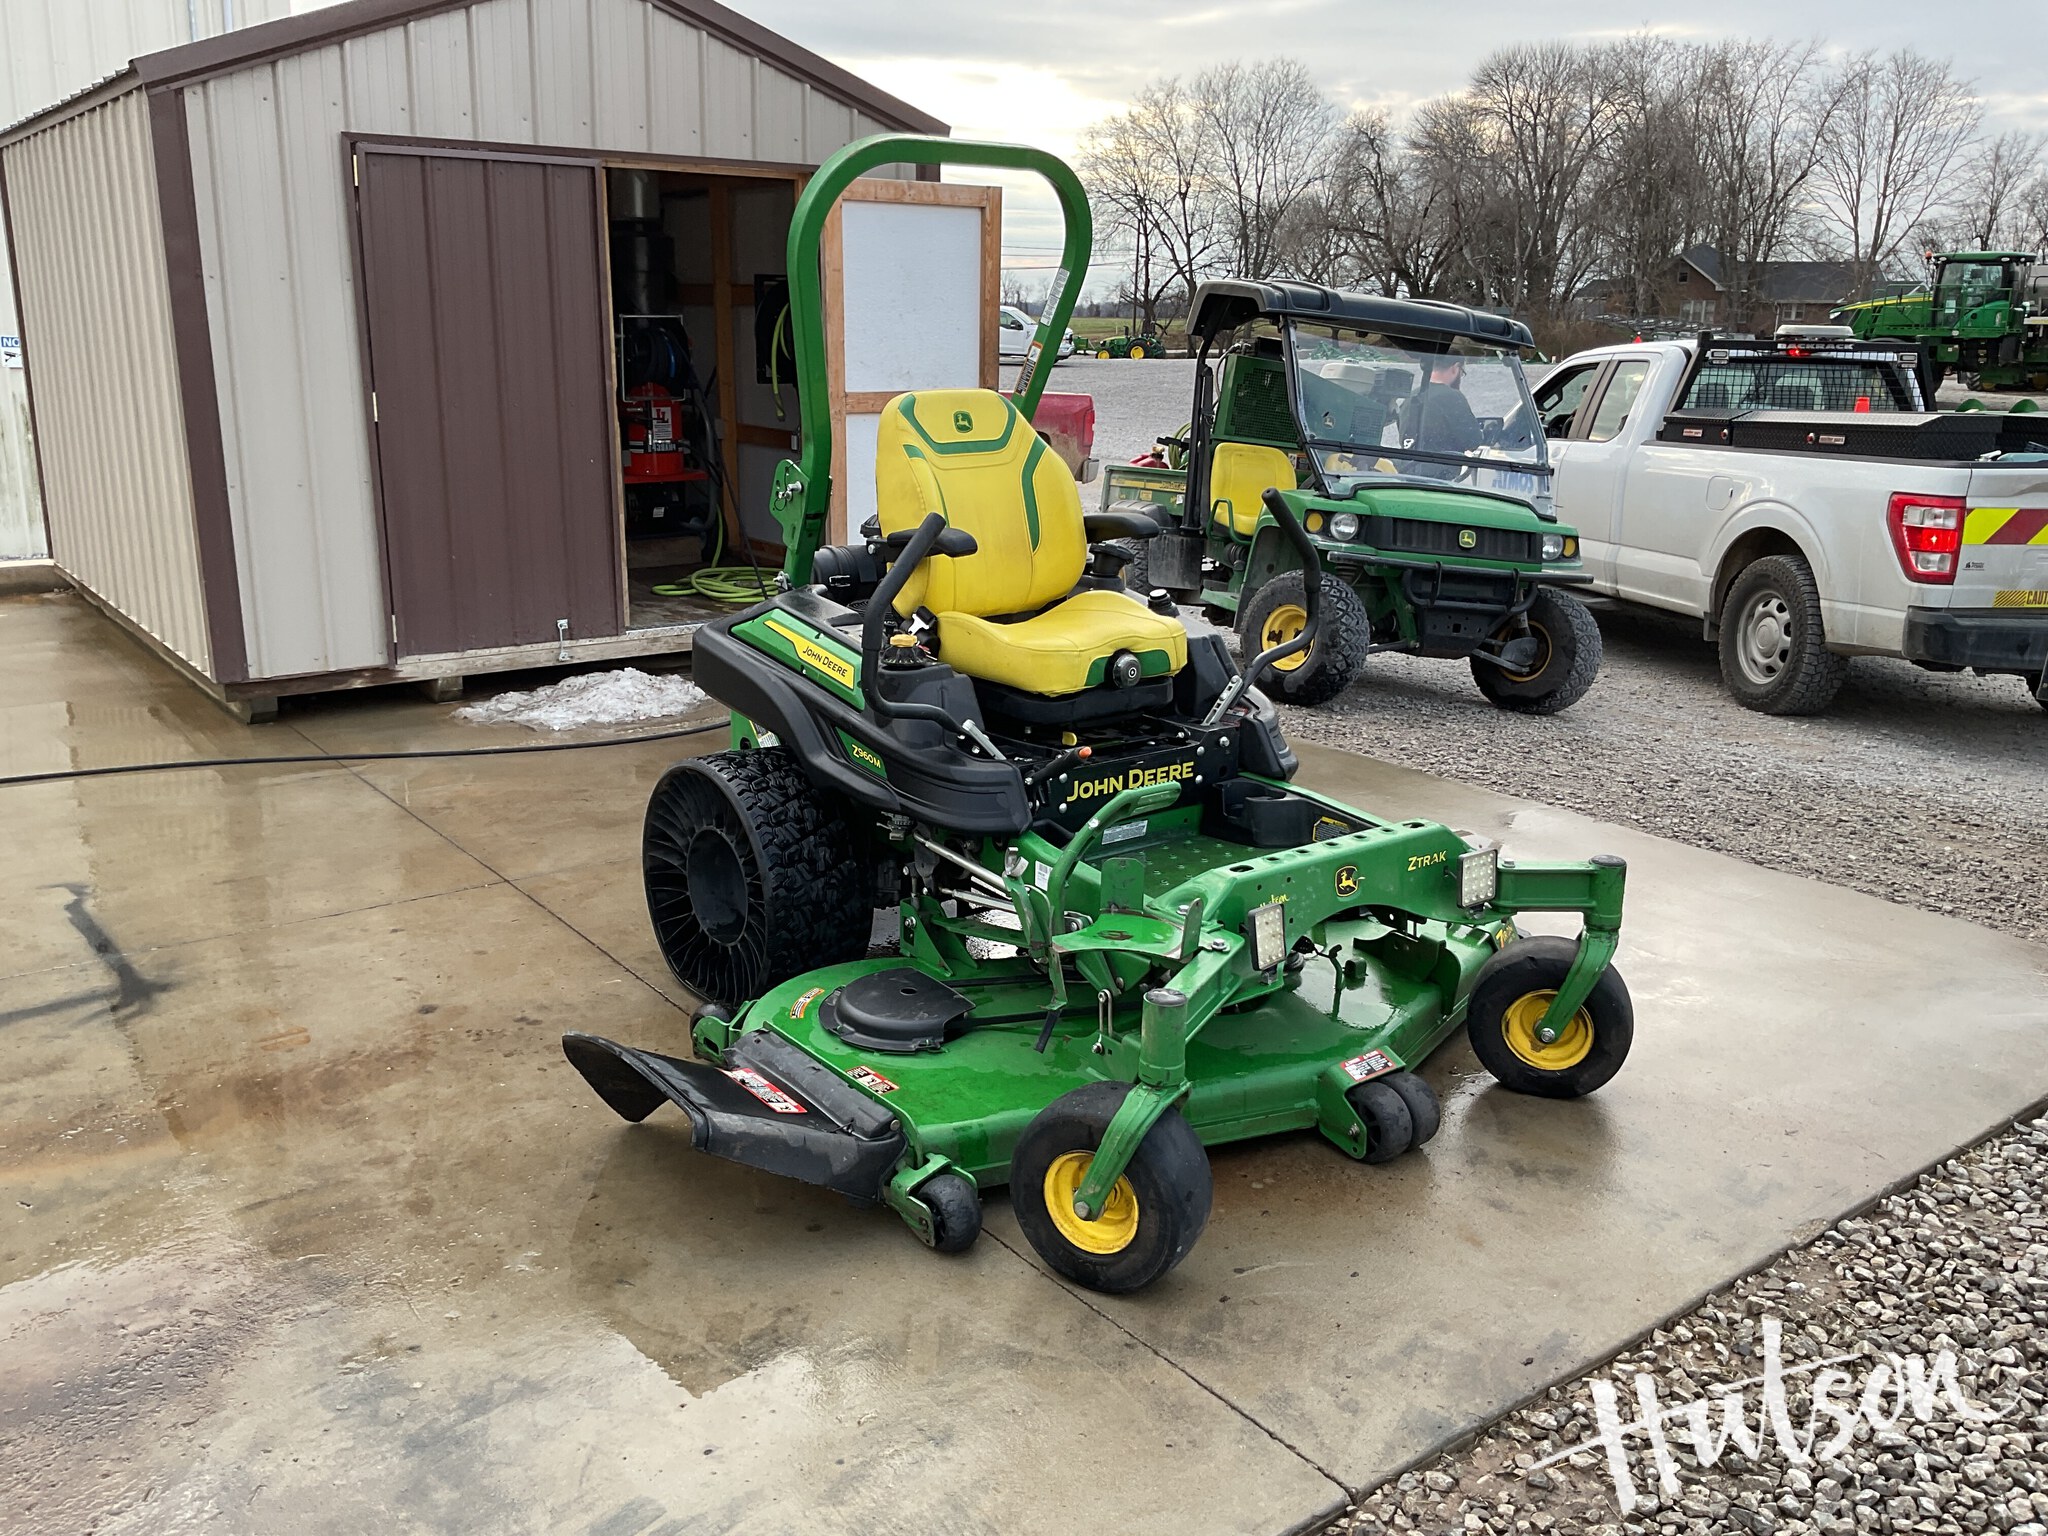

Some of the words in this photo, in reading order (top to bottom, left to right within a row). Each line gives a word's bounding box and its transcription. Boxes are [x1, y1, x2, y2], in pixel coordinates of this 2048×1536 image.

[802, 646, 823, 662] JOHN
[822, 656, 848, 677] DEERE
[852, 744, 881, 768] Z960M
[1066, 775, 1123, 802] JOHN
[1128, 761, 1194, 790] DEERE
[1407, 850, 1447, 872] ZTRAK
